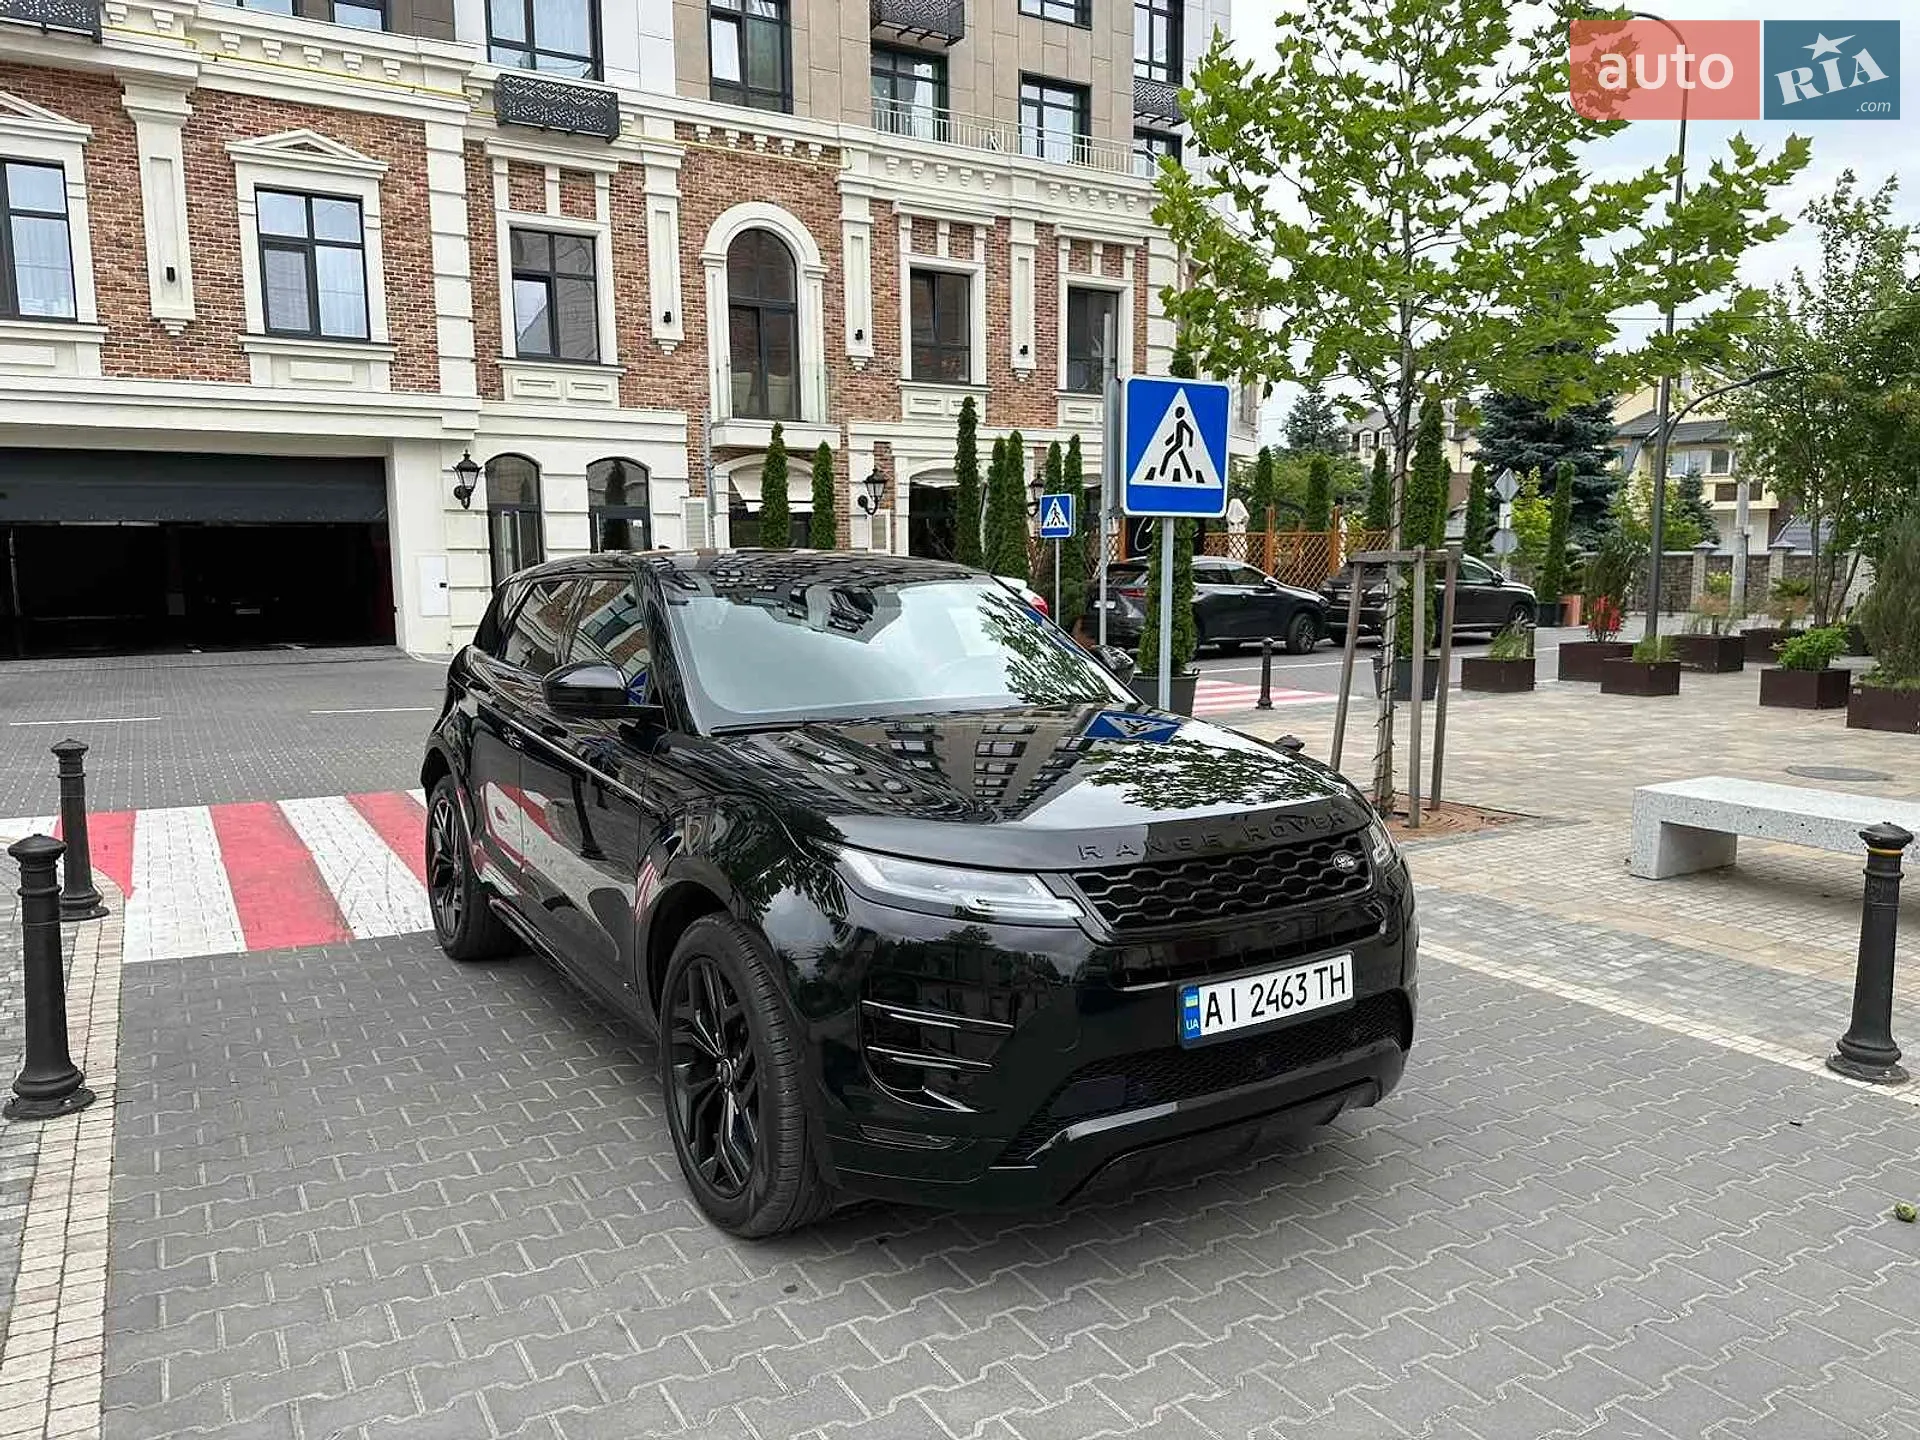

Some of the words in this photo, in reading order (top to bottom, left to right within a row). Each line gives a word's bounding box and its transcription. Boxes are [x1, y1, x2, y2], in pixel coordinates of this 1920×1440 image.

[1077, 833, 1223, 861] RANGE
[1240, 810, 1346, 842] ROVER
[1204, 987, 1237, 1028] AI
[1250, 971, 1307, 1018] 2463
[1313, 961, 1346, 1000] TH
[1185, 1018, 1200, 1031] UA
